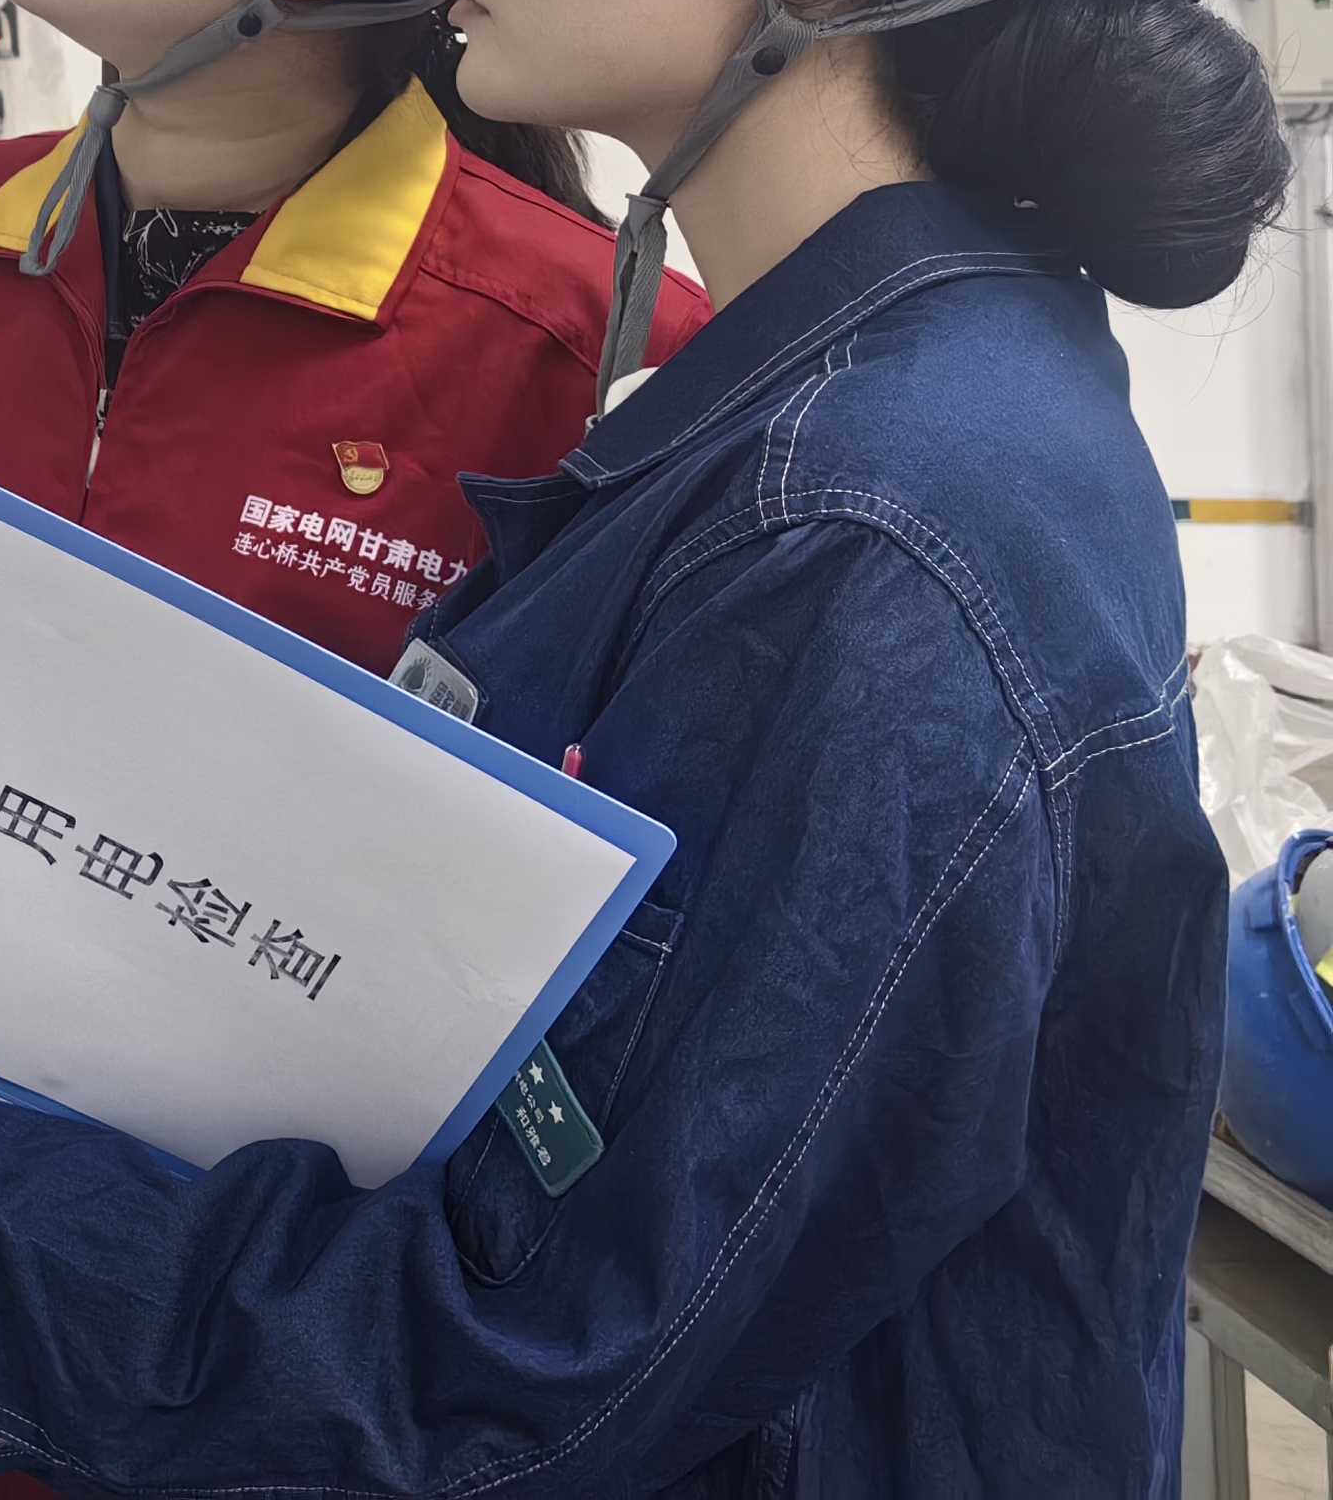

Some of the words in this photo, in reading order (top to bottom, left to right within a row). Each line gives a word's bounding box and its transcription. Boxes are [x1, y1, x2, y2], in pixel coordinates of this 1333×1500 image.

[231, 531, 438, 611] 连心桥共产党员服务
[239, 494, 469, 586] 国家电网甘肃电力
